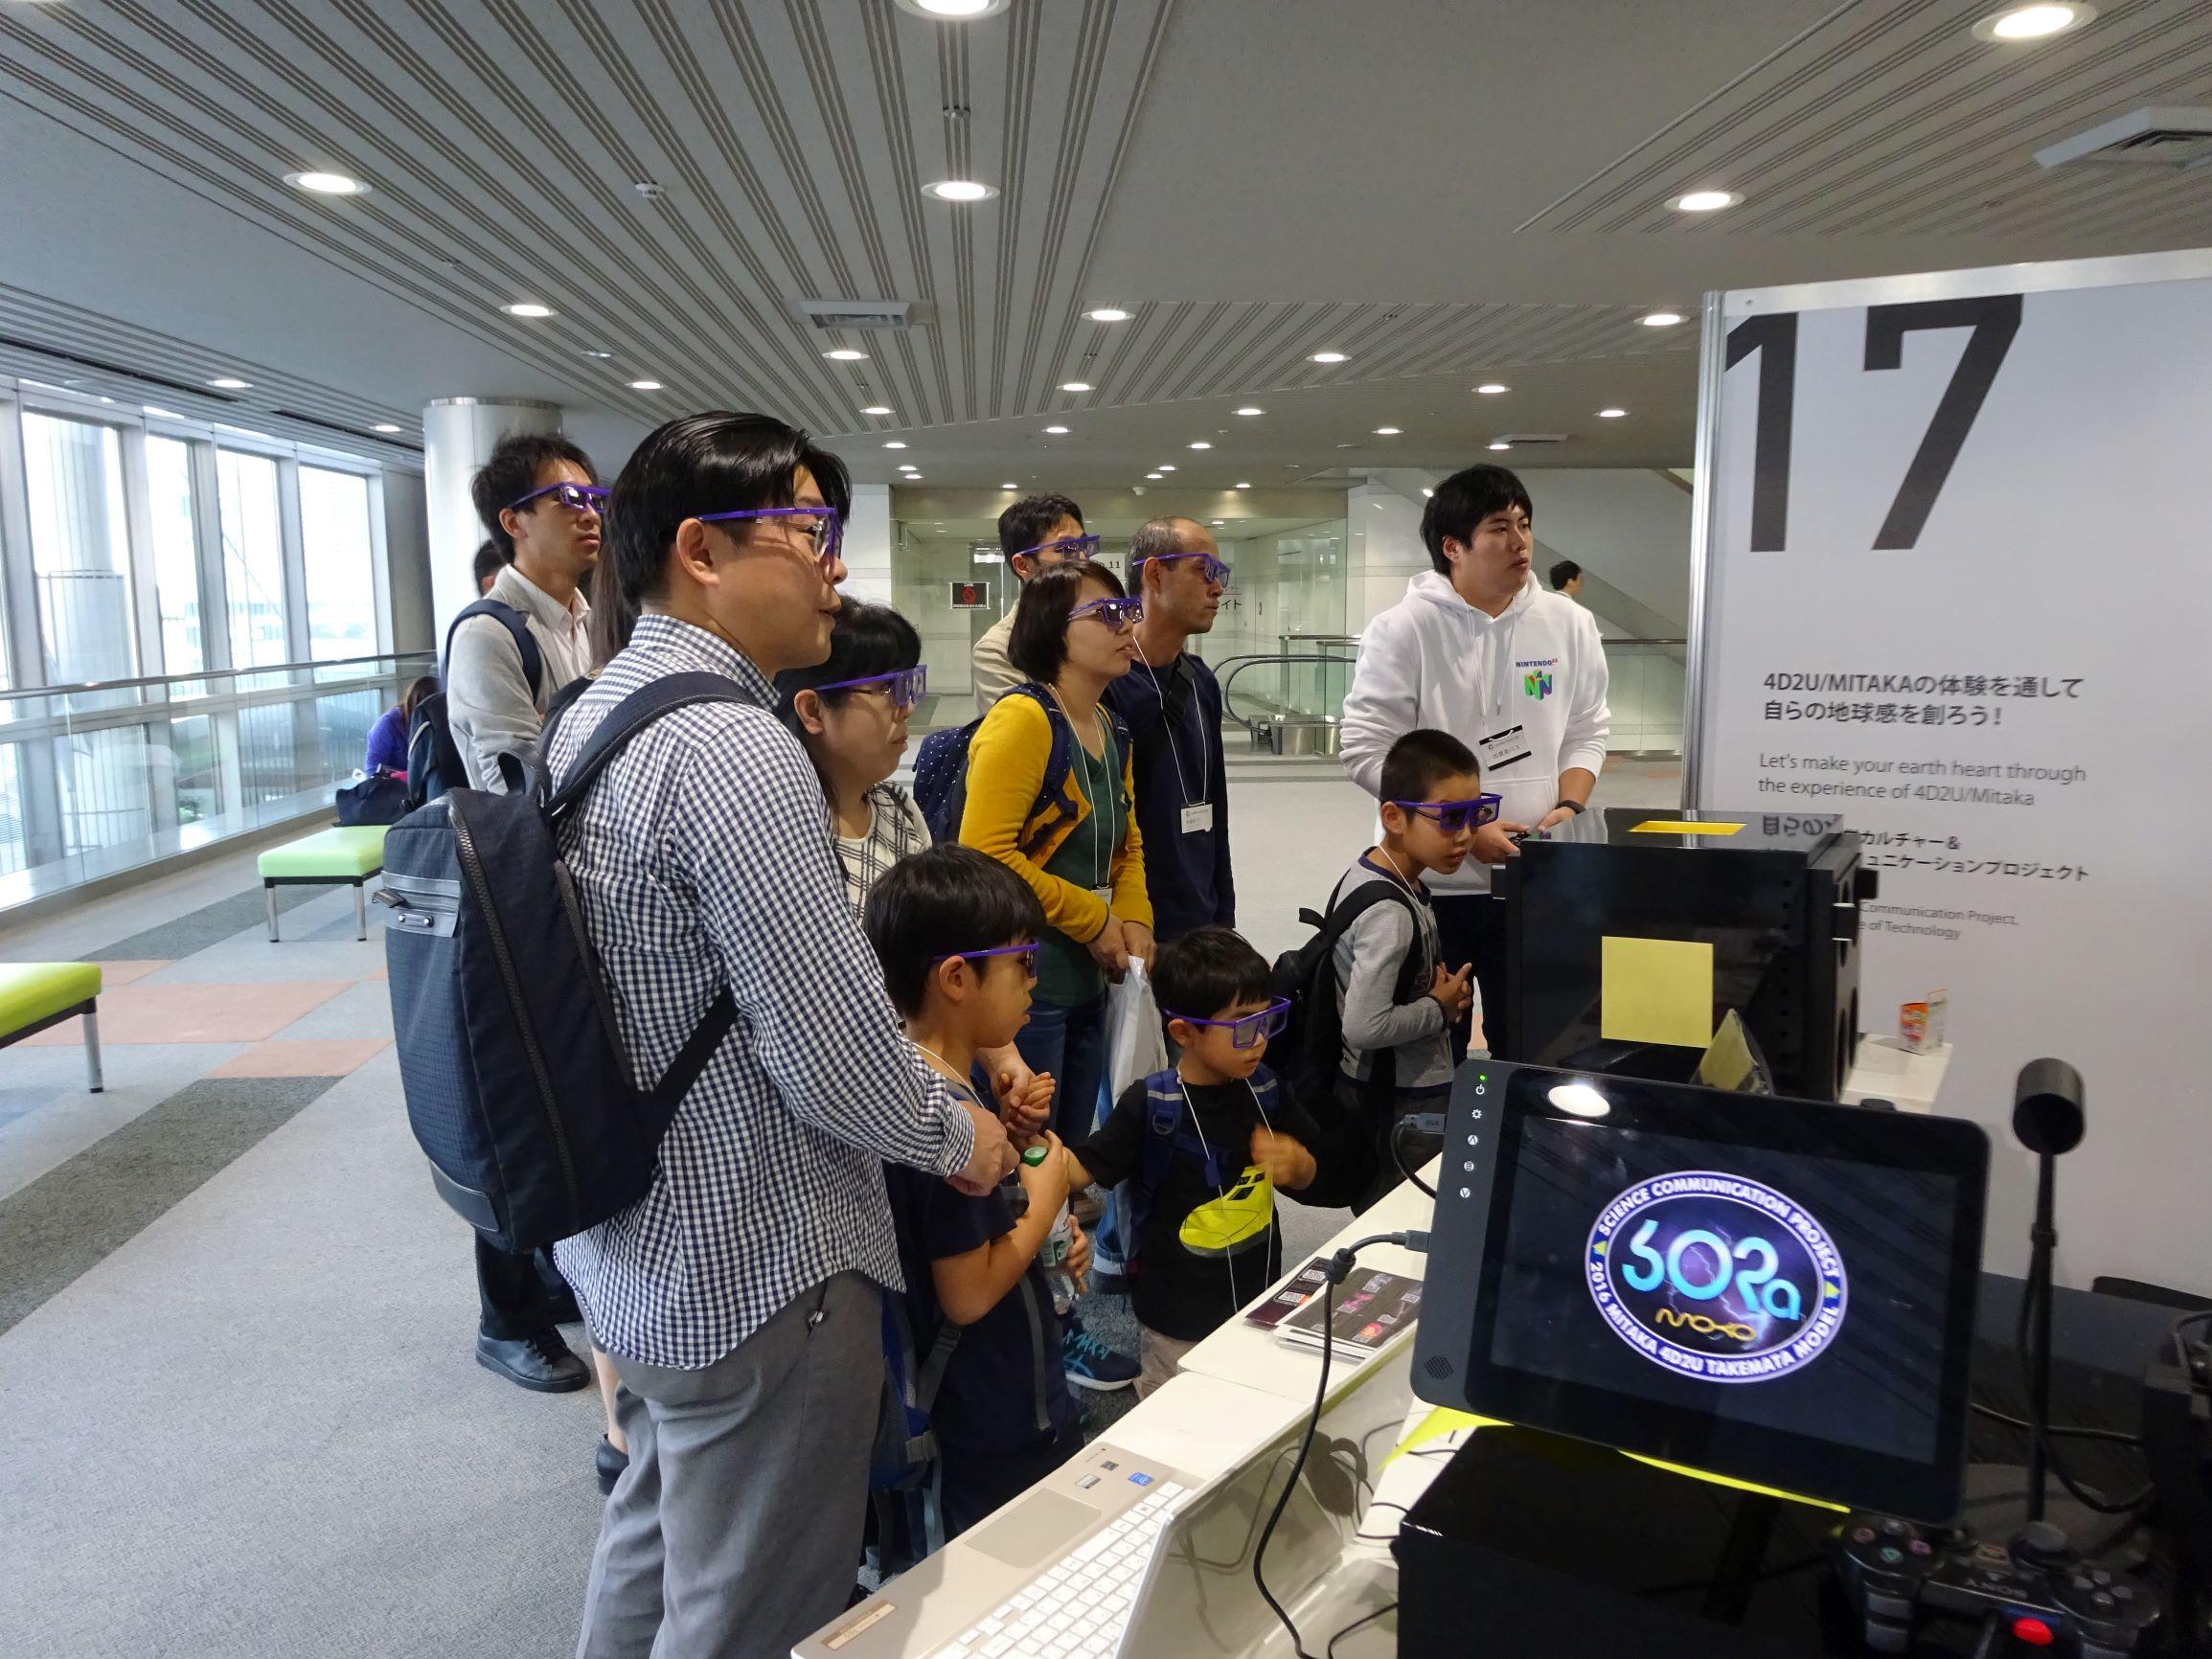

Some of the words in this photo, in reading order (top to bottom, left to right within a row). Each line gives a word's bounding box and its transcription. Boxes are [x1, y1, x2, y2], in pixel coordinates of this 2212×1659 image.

[1723, 292, 2024, 553] 17
[1220, 599, 1243, 611] イト
[1763, 672, 2085, 698] 4D2U/MITAKAの体験を通して
[1764, 700, 2002, 726] 自らの地球感を創ろう!
[1760, 752, 1798, 769] Let's
[1803, 755, 1850, 772] make
[1854, 760, 1894, 776] your
[1898, 759, 1947, 777] earth
[1951, 761, 2001, 778] heart
[2006, 762, 2087, 784] through
[1758, 777, 1786, 793] the
[1790, 782, 1887, 799] experience
[1892, 782, 1912, 798] of
[1913, 784, 2035, 807] 4D2U/Mitaka
[1845, 829, 1962, 851] カルチャー&
[1866, 854, 2089, 882] ュニケーションプロジェクト
[1860, 900, 1966, 920] Communication
[1868, 920, 1882, 931] of
[1884, 920, 1962, 941] Technology
[1598, 1187, 1652, 1237] SCIENCE
[1651, 1176, 1792, 1218] COMMUNICATION
[1786, 1211, 1840, 1278] PROJECT
[1589, 1261, 1612, 1304] 2016
[1604, 1302, 1659, 1356] MITAKA
[1657, 1345, 1705, 1373] 4D2U
[1704, 1349, 1797, 1376] TAKEMATA
[1791, 1306, 1840, 1359] MODEL
